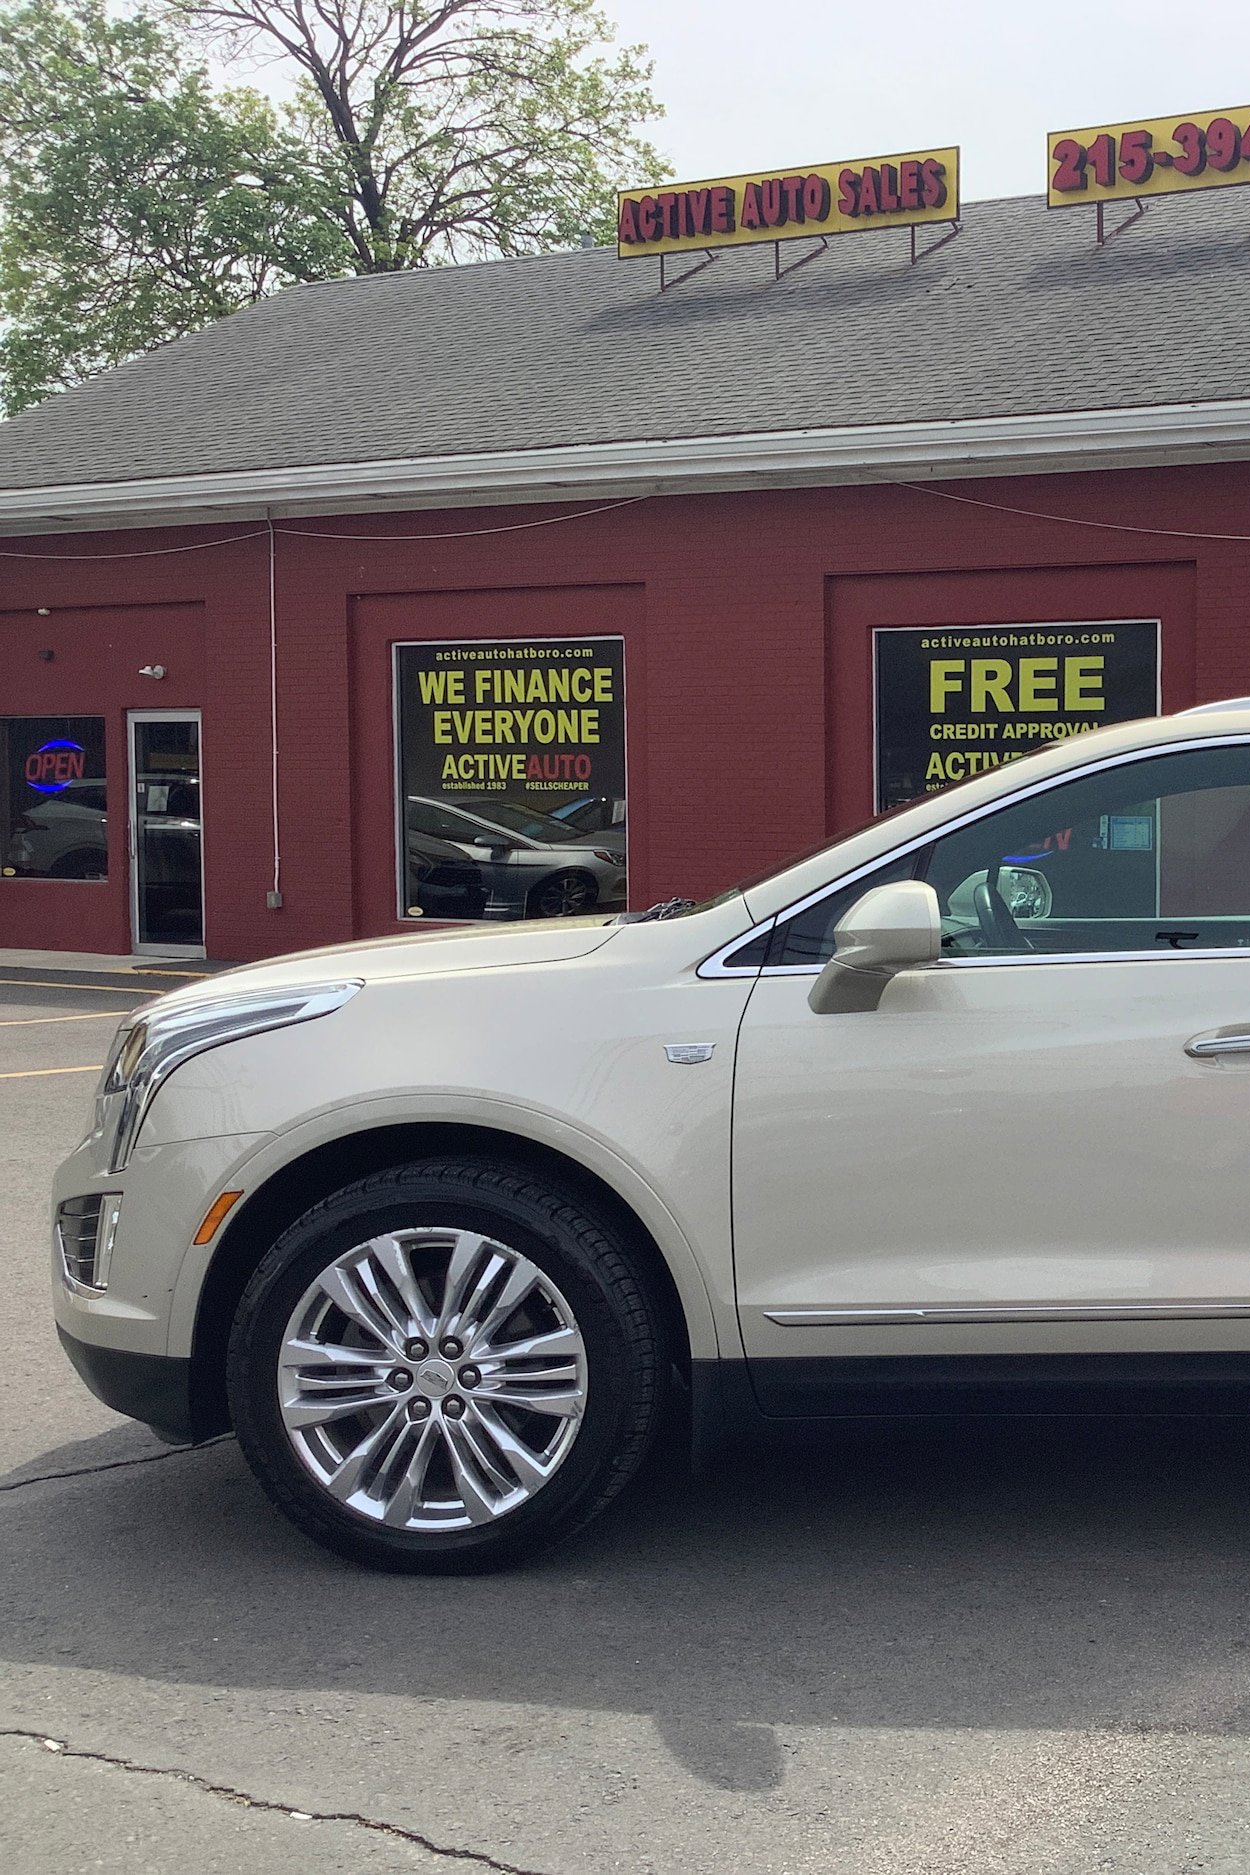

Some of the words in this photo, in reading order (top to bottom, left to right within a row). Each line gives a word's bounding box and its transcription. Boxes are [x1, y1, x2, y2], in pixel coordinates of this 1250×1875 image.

[620, 186, 736, 244] ACTIVE
[741, 173, 831, 228] AUTO
[838, 158, 948, 218] SALES
[435, 647, 594, 661] activeautohatboro.com
[920, 632, 1116, 649] activeautohatboro.com
[417, 670, 466, 705] WE
[474, 667, 614, 704] FINANCE
[929, 655, 1106, 714] FREE
[433, 708, 601, 744] EVERYONE
[929, 723, 999, 740] CREDIT
[25, 751, 85, 781] OPEN
[441, 781, 486, 790] established
[486, 781, 507, 790] 1983
[525, 781, 590, 791] #SELLSCHEAPER
